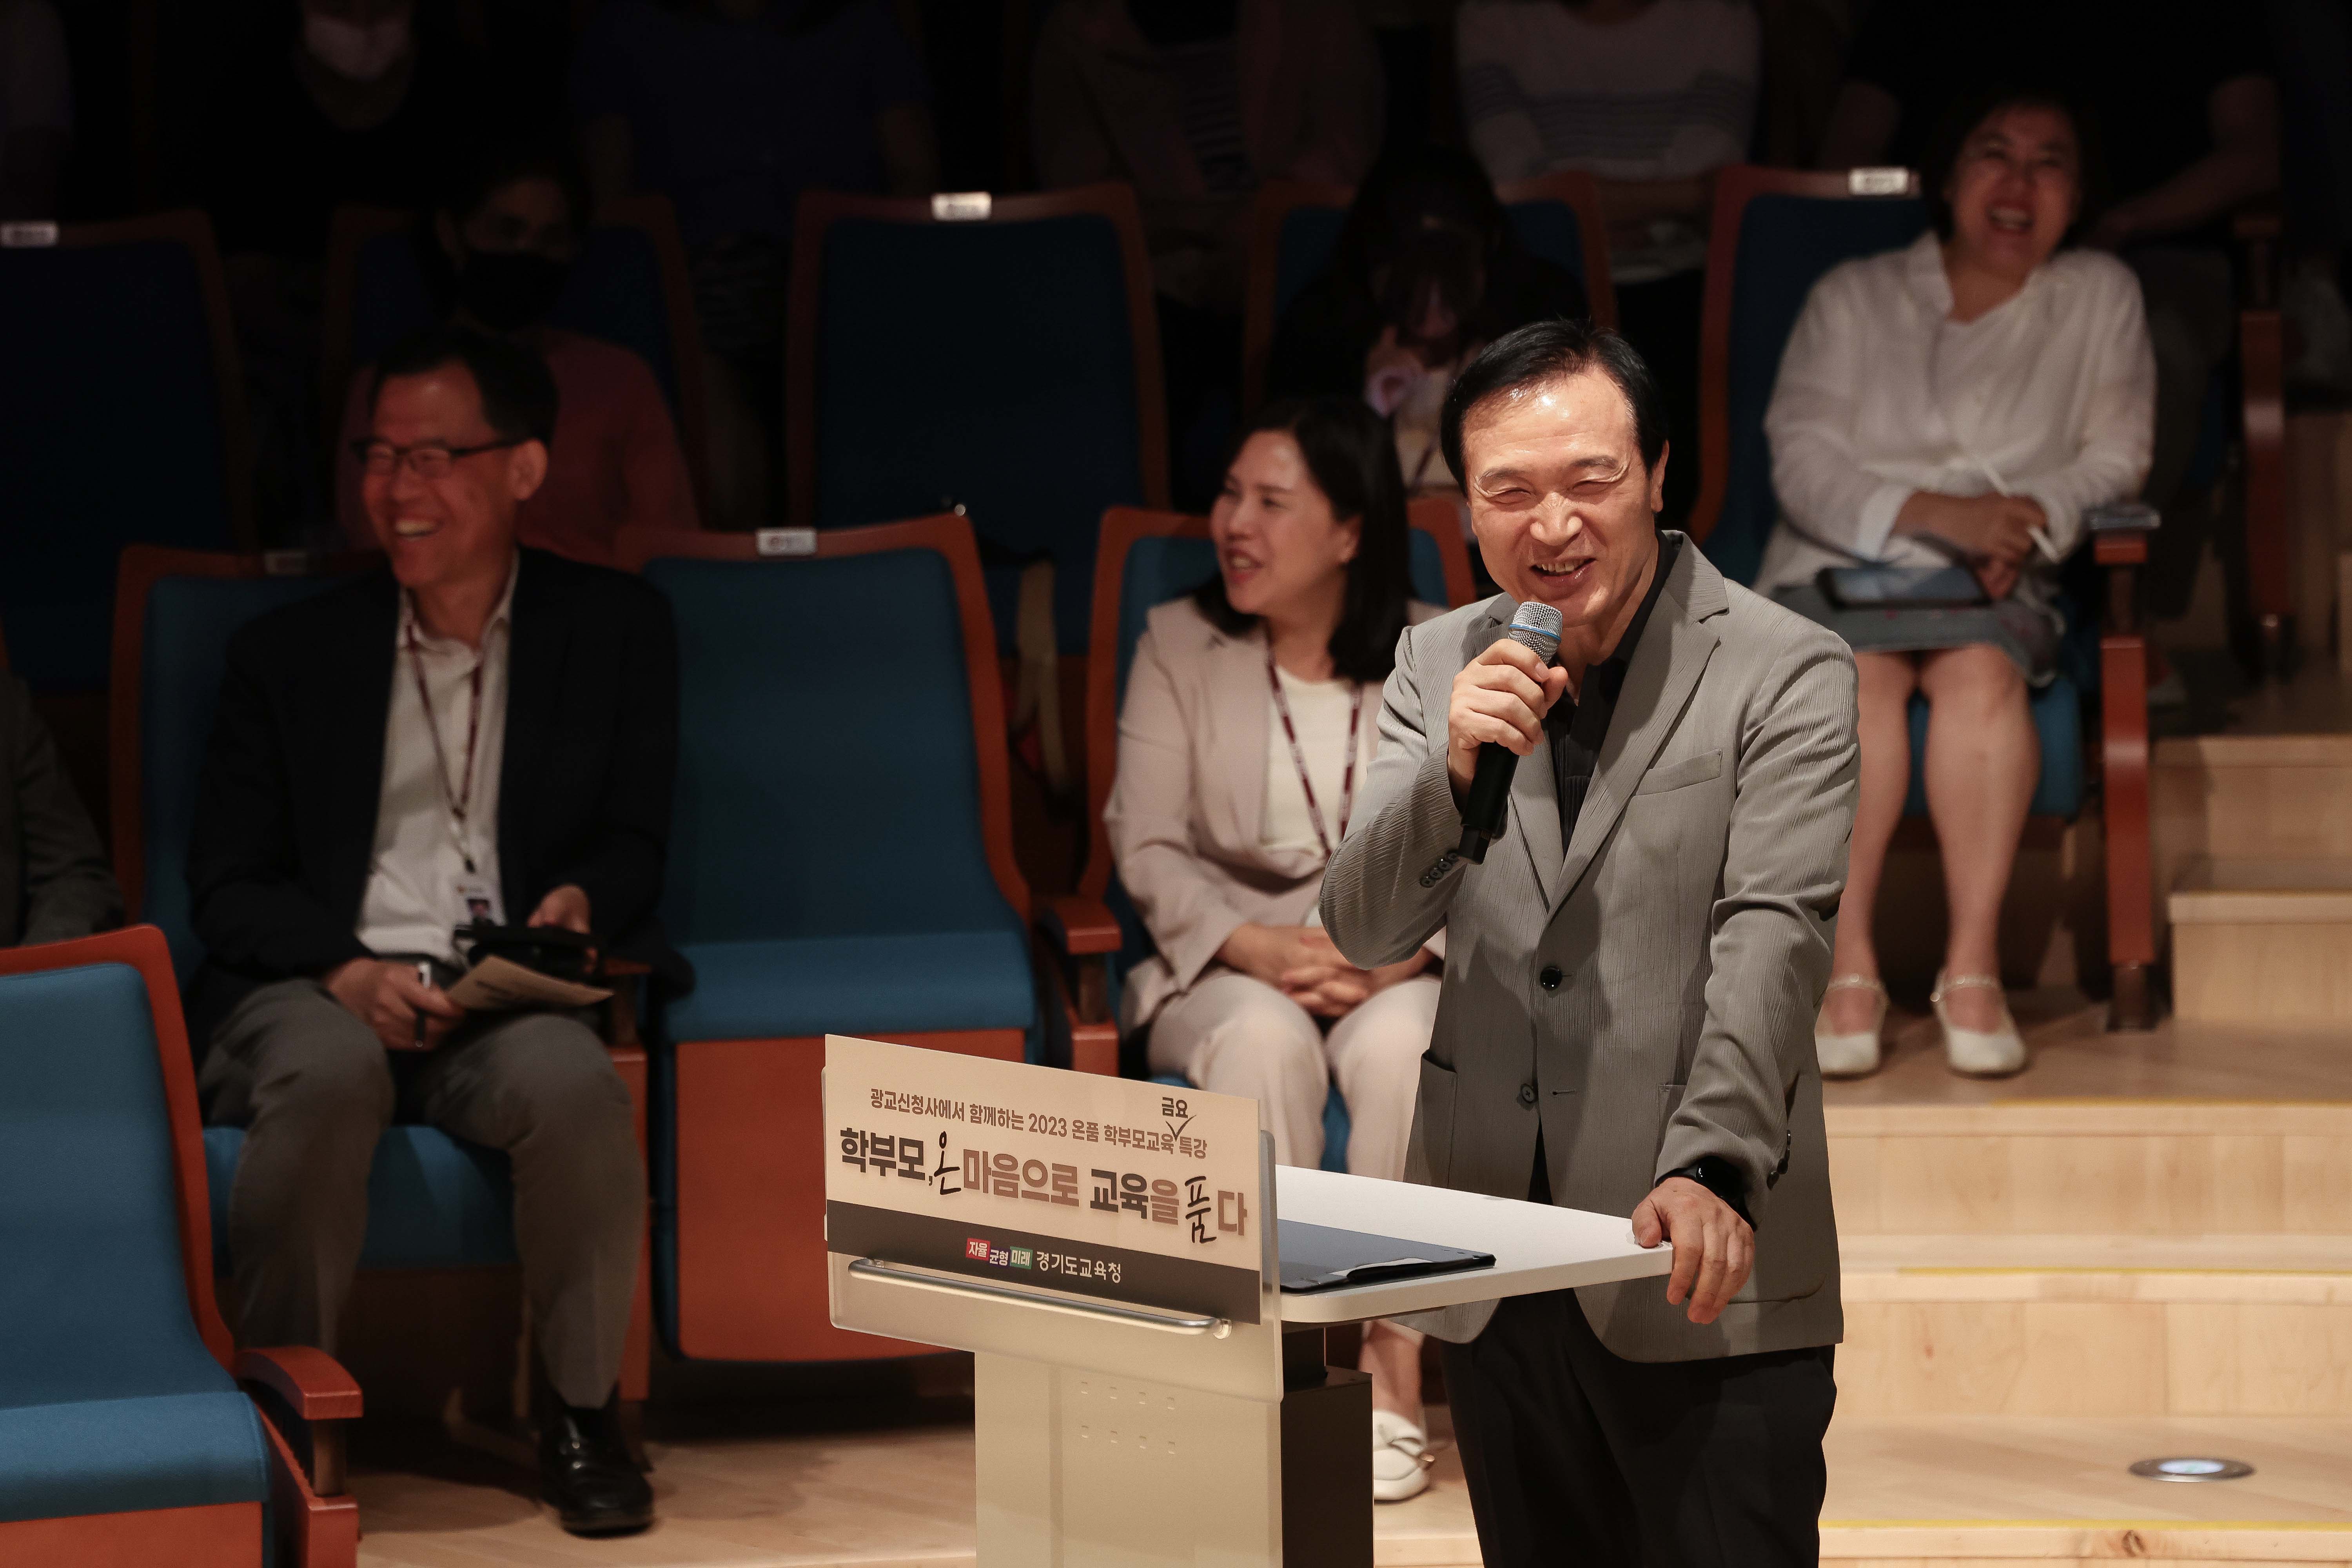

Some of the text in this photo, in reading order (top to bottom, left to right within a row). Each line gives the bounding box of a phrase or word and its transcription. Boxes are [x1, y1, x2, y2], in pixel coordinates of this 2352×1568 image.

[871, 1088, 1207, 1159] 광교신청사에서 함께하는 2023 온품 학부모교육 특강
[1161, 1096, 1188, 1119] 금요
[1090, 1169, 1179, 1225] 교육을
[968, 1241, 1121, 1283] 자율 균형 미래 경기도교육청
